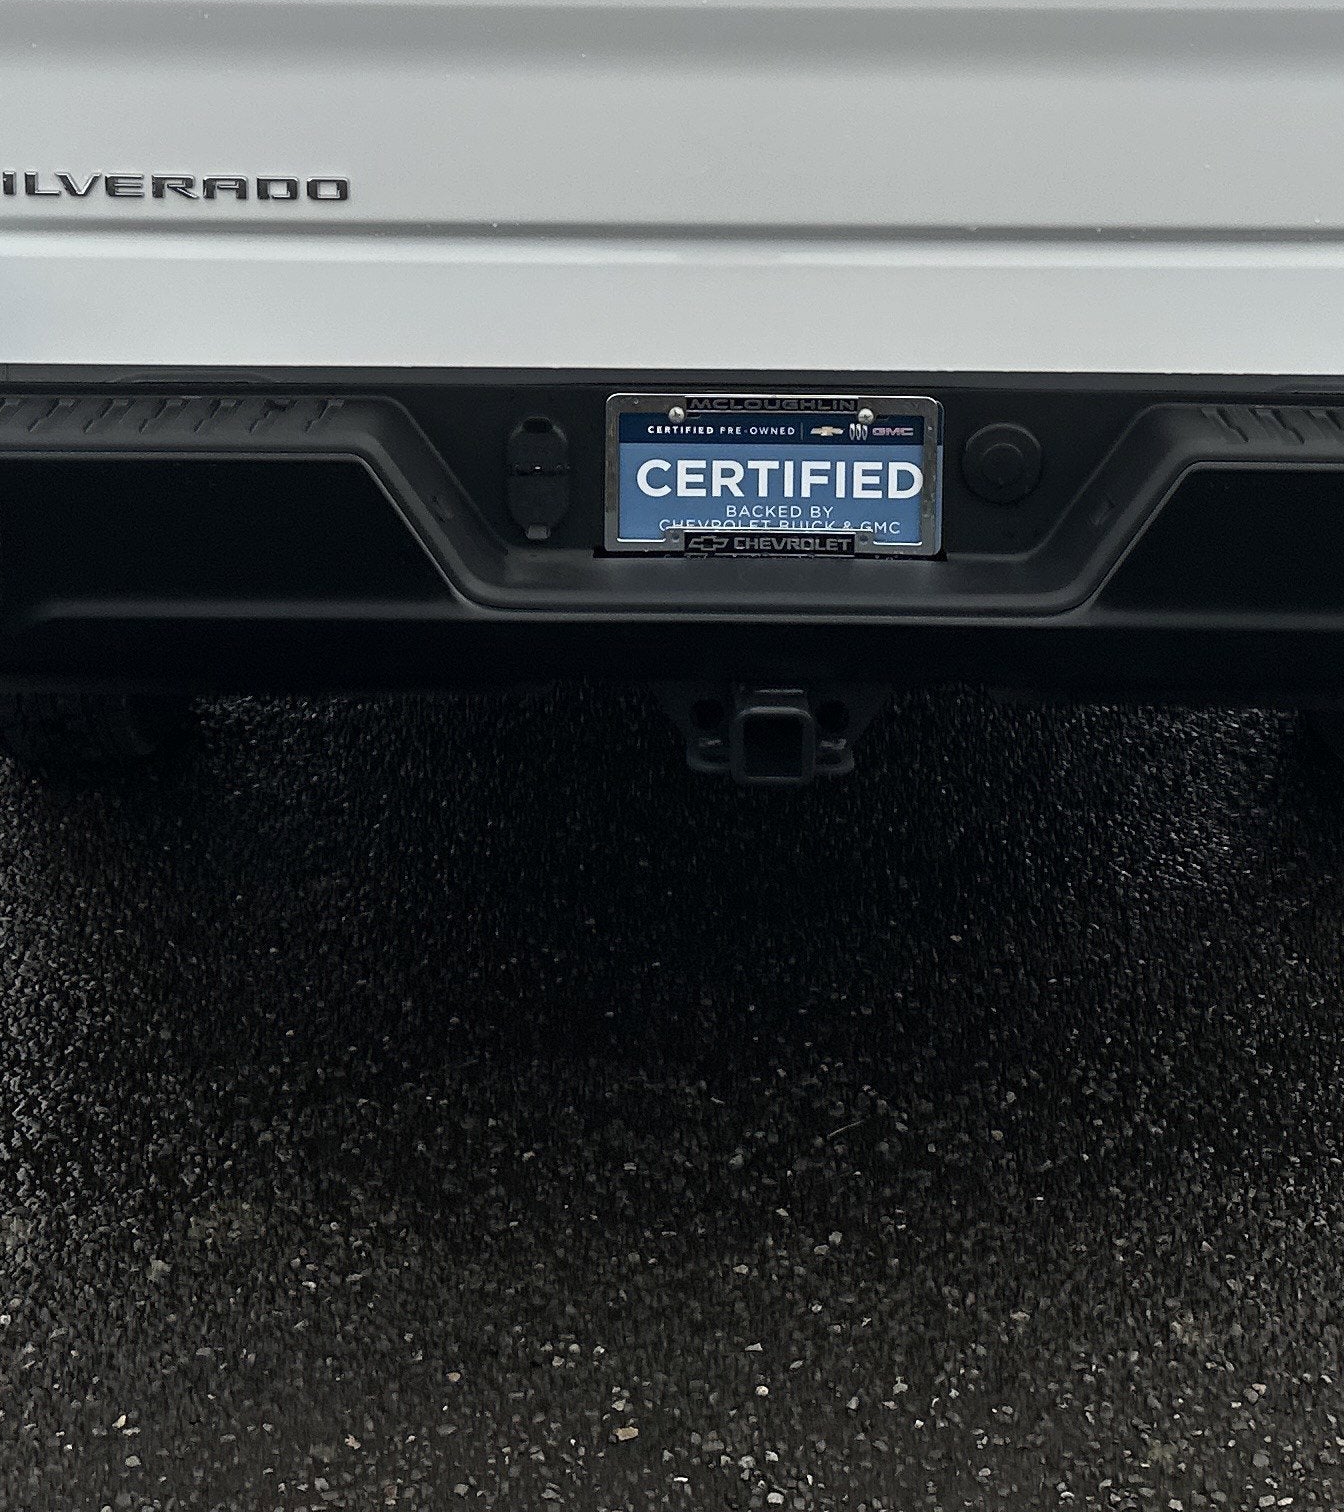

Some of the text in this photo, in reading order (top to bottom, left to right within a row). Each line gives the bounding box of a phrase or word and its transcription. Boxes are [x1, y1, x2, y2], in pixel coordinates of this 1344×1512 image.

[689, 398, 856, 412] MCLOUGHLIN
[647, 425, 714, 435] CERTIFIED
[871, 426, 914, 437] GMC
[635, 458, 924, 500] CERTIFIED
[725, 504, 834, 519] BACKED BY
[860, 521, 902, 535] GMC
[732, 535, 853, 552] CHEVROLET
